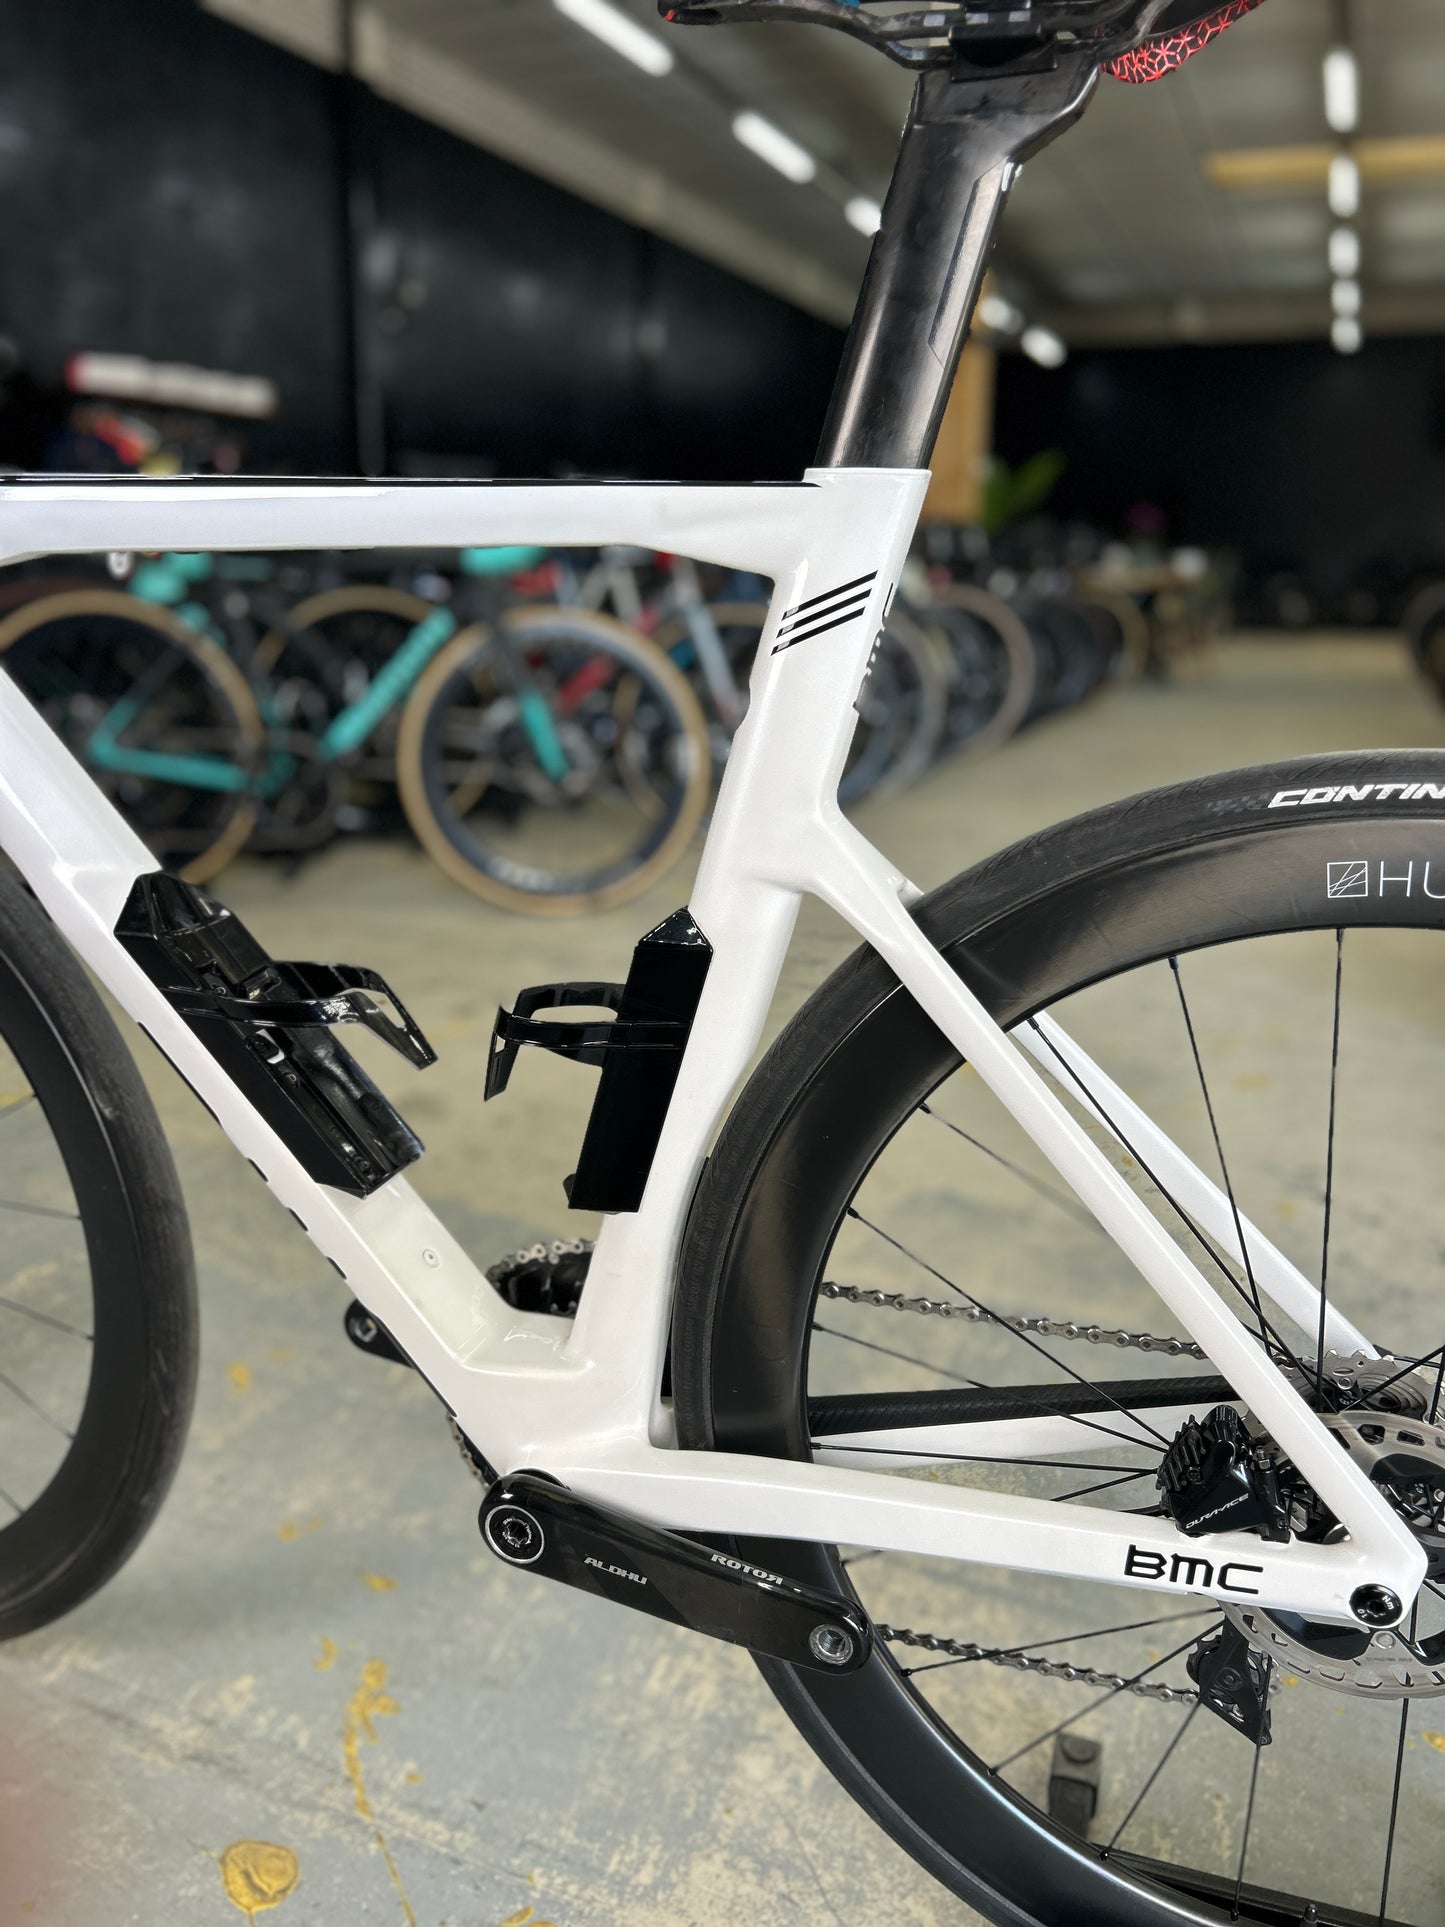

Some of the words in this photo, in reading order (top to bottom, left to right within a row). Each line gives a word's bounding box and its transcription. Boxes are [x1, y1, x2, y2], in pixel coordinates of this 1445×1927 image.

[1268, 783, 1445, 809] CONTIN
[1185, 1493, 1249, 1529] DURA-ACE
[584, 1556, 648, 1585] ALDHU
[711, 1553, 783, 1585] ROTOR
[1124, 1544, 1264, 1595] BMC
